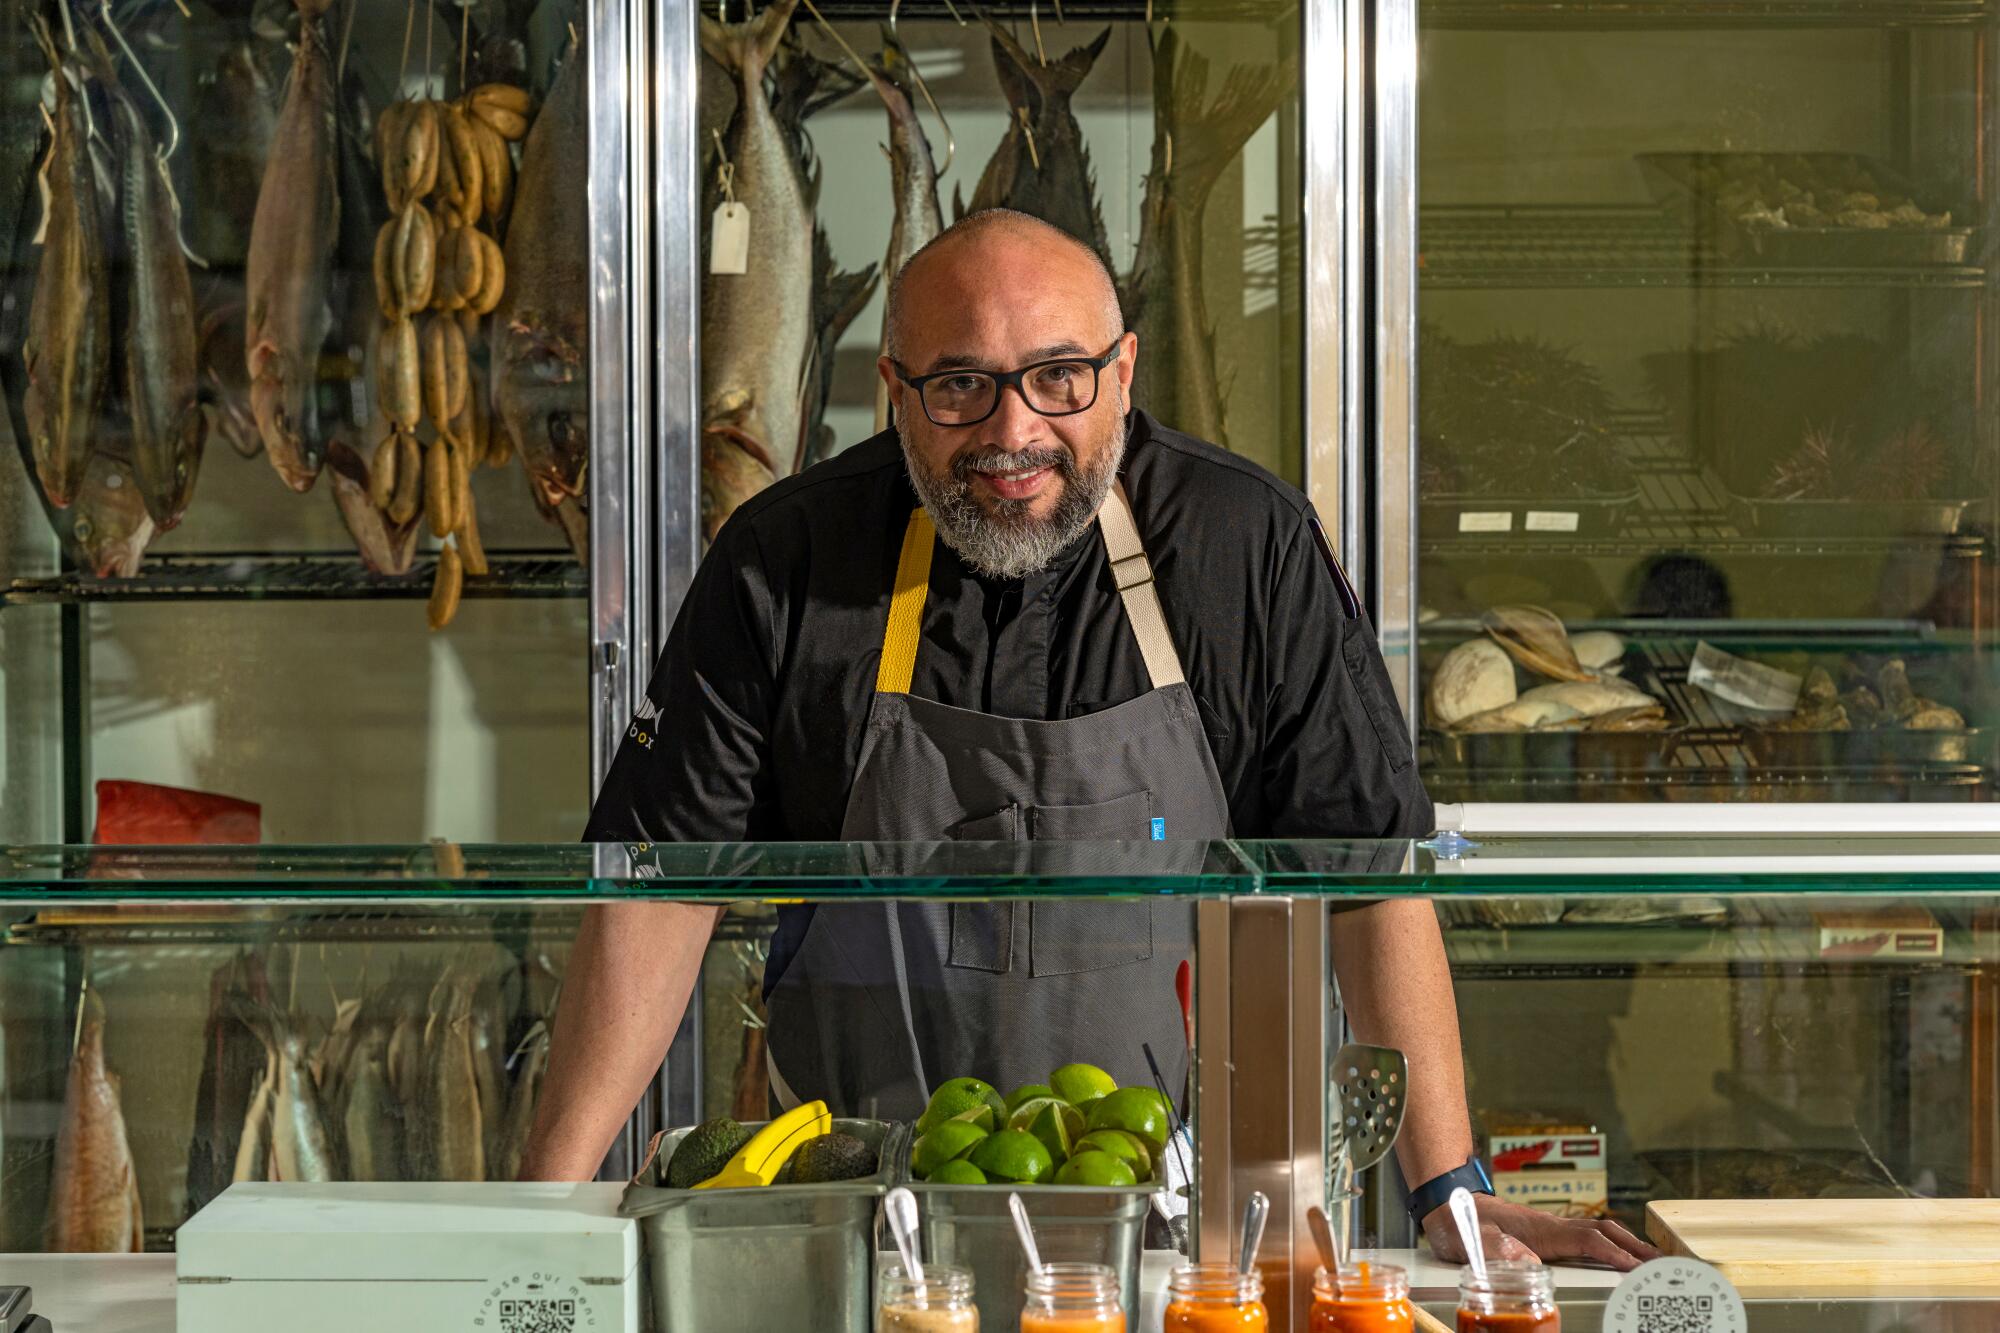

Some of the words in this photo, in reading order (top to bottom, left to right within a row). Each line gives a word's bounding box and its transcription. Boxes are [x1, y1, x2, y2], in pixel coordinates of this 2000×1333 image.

[629, 722, 654, 750] box
[473, 1276, 520, 1326] Browse
[532, 1272, 561, 1284] our
[568, 1285, 596, 1326] menu
[1614, 1271, 1662, 1321] Browse
[1673, 1267, 1703, 1280] our
[1709, 1281, 1737, 1322] menu
